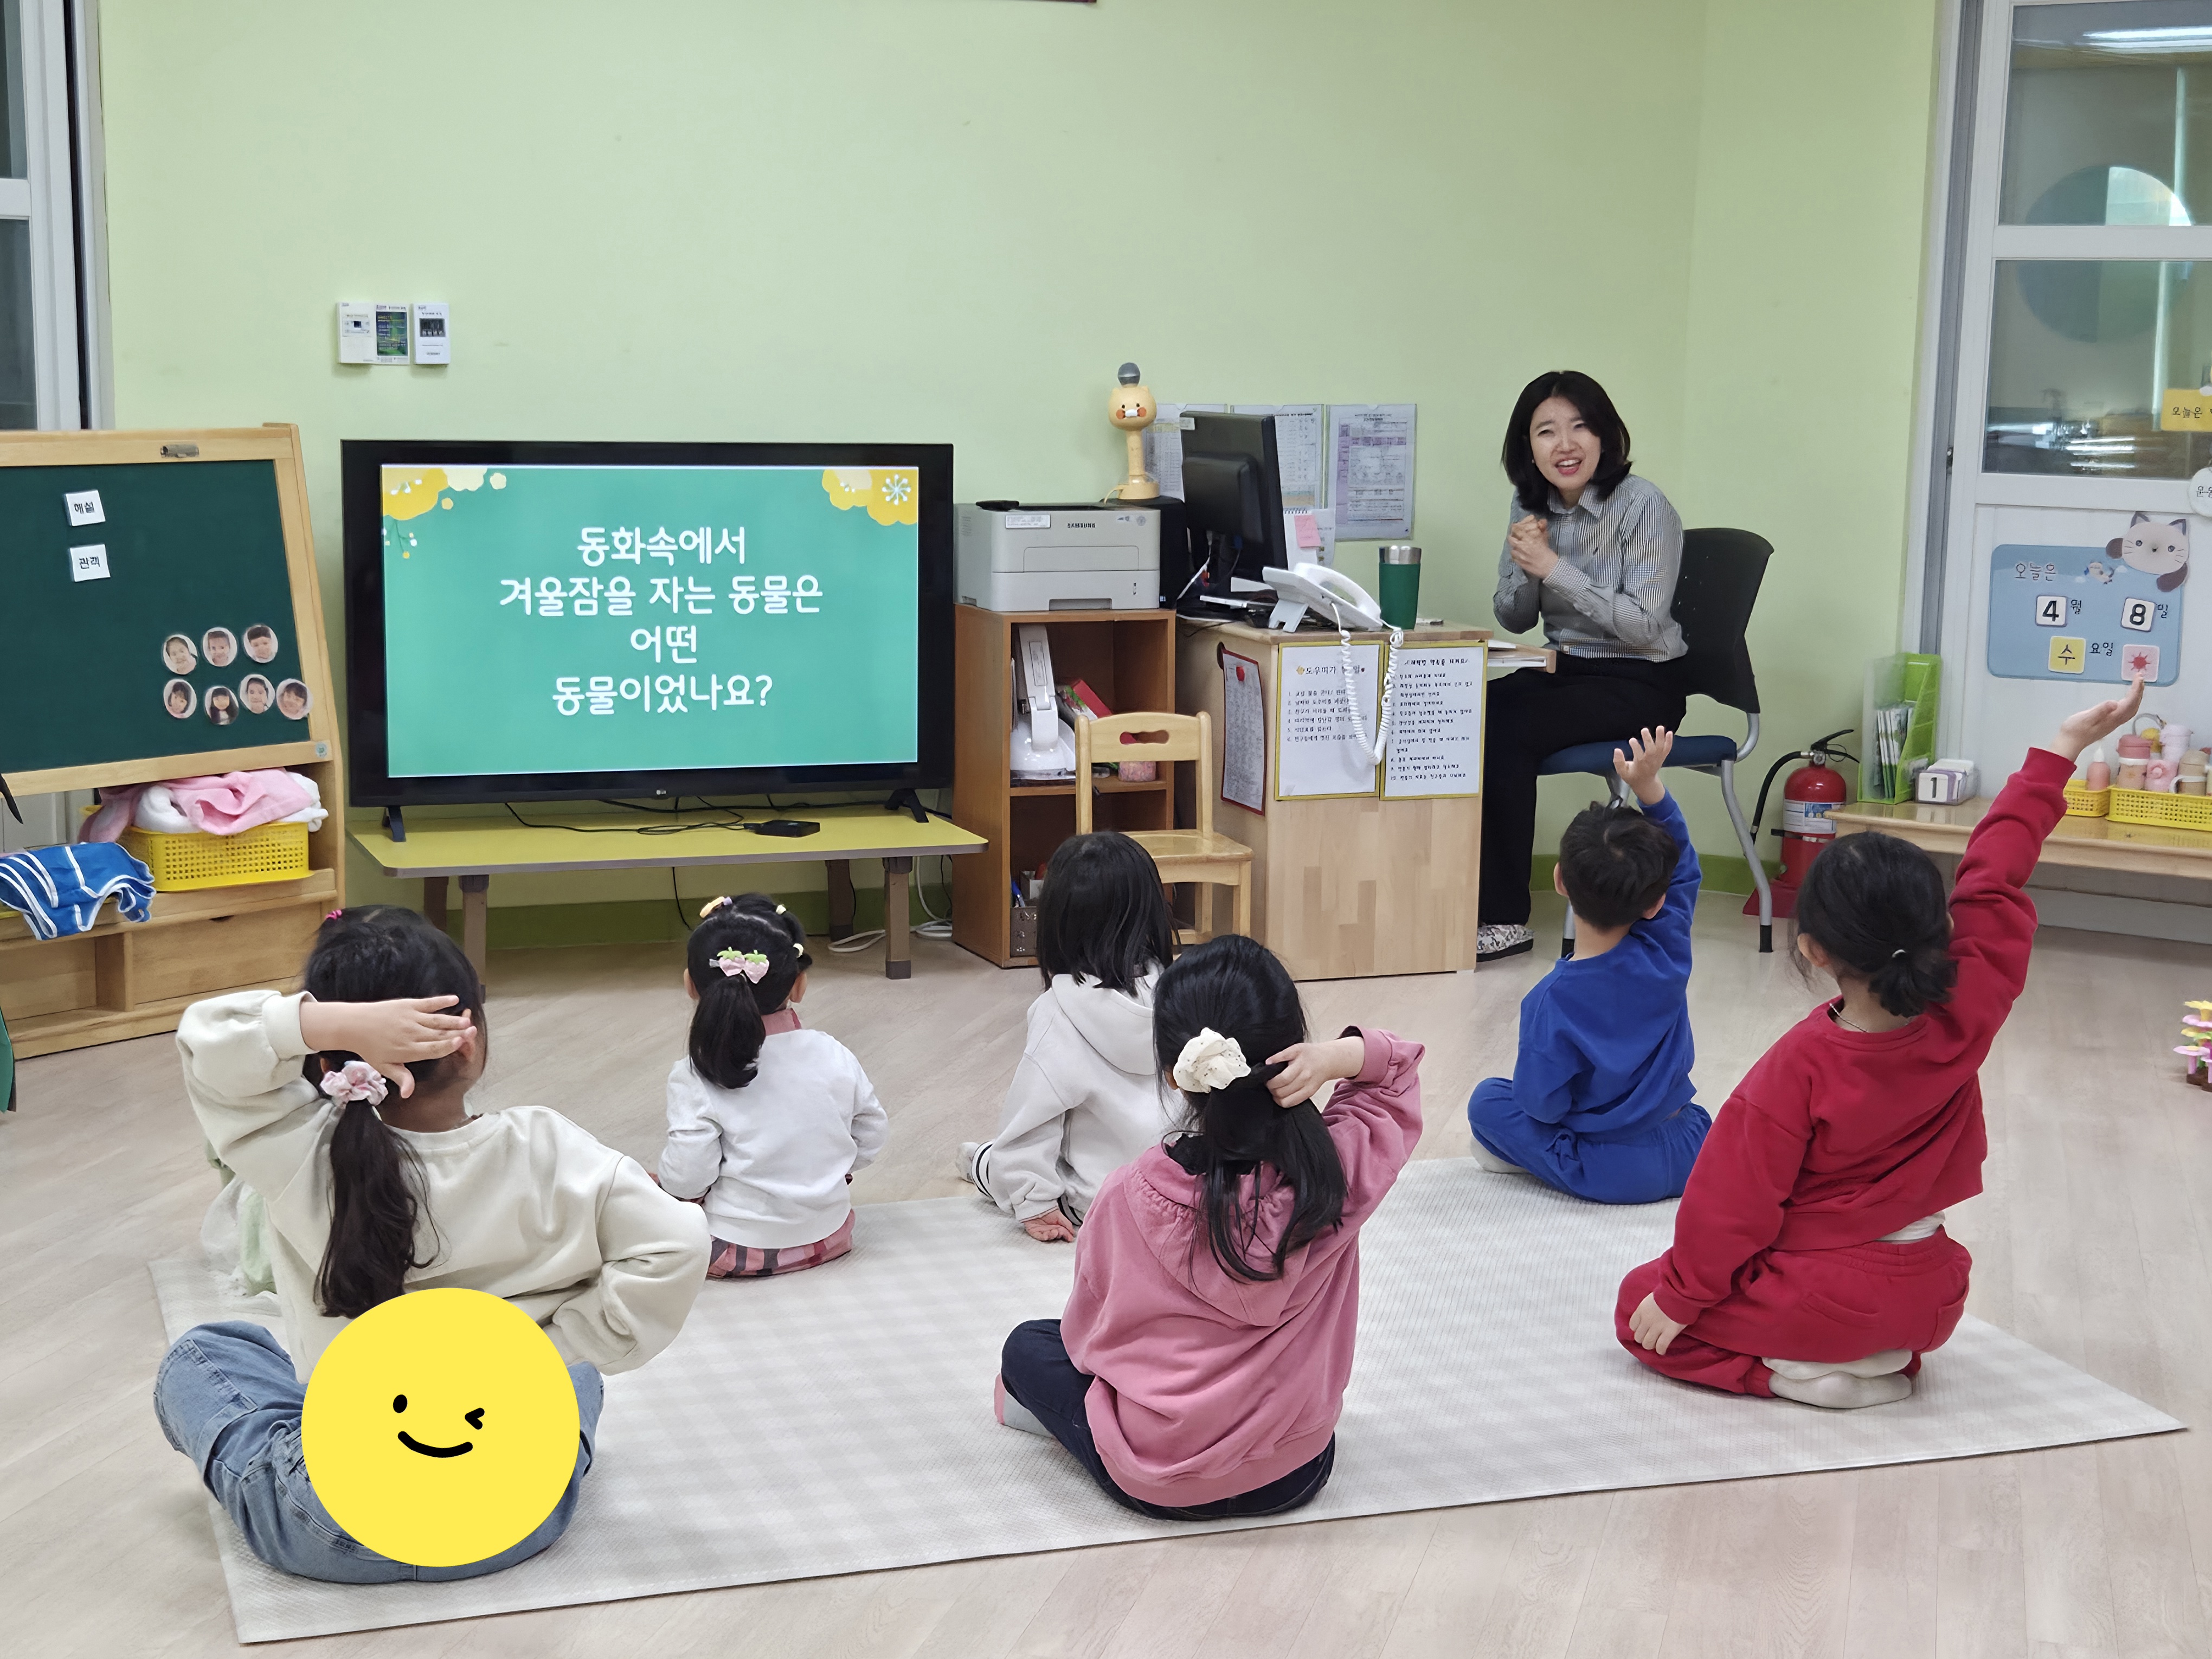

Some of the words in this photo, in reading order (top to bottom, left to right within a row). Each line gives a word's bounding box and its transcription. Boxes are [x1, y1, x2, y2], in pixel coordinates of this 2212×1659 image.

[73, 500, 95, 515] 해설
[576, 525, 747, 568] 동화속에서
[2014, 562, 2056, 582] 오늘은
[499, 577, 637, 617] 겨울잠을
[648, 577, 715, 616] 자는
[728, 575, 824, 615] 동물은
[2042, 599, 2059, 622] 4
[2070, 599, 2082, 616] 월
[2129, 603, 2147, 626] 8
[2157, 603, 2169, 619] 일
[629, 625, 698, 664] 어떤
[2057, 644, 2075, 666] 수
[2089, 641, 2114, 657] 요일
[552, 673, 774, 716] 동물이었나요?
[1930, 776, 1938, 799] 1
